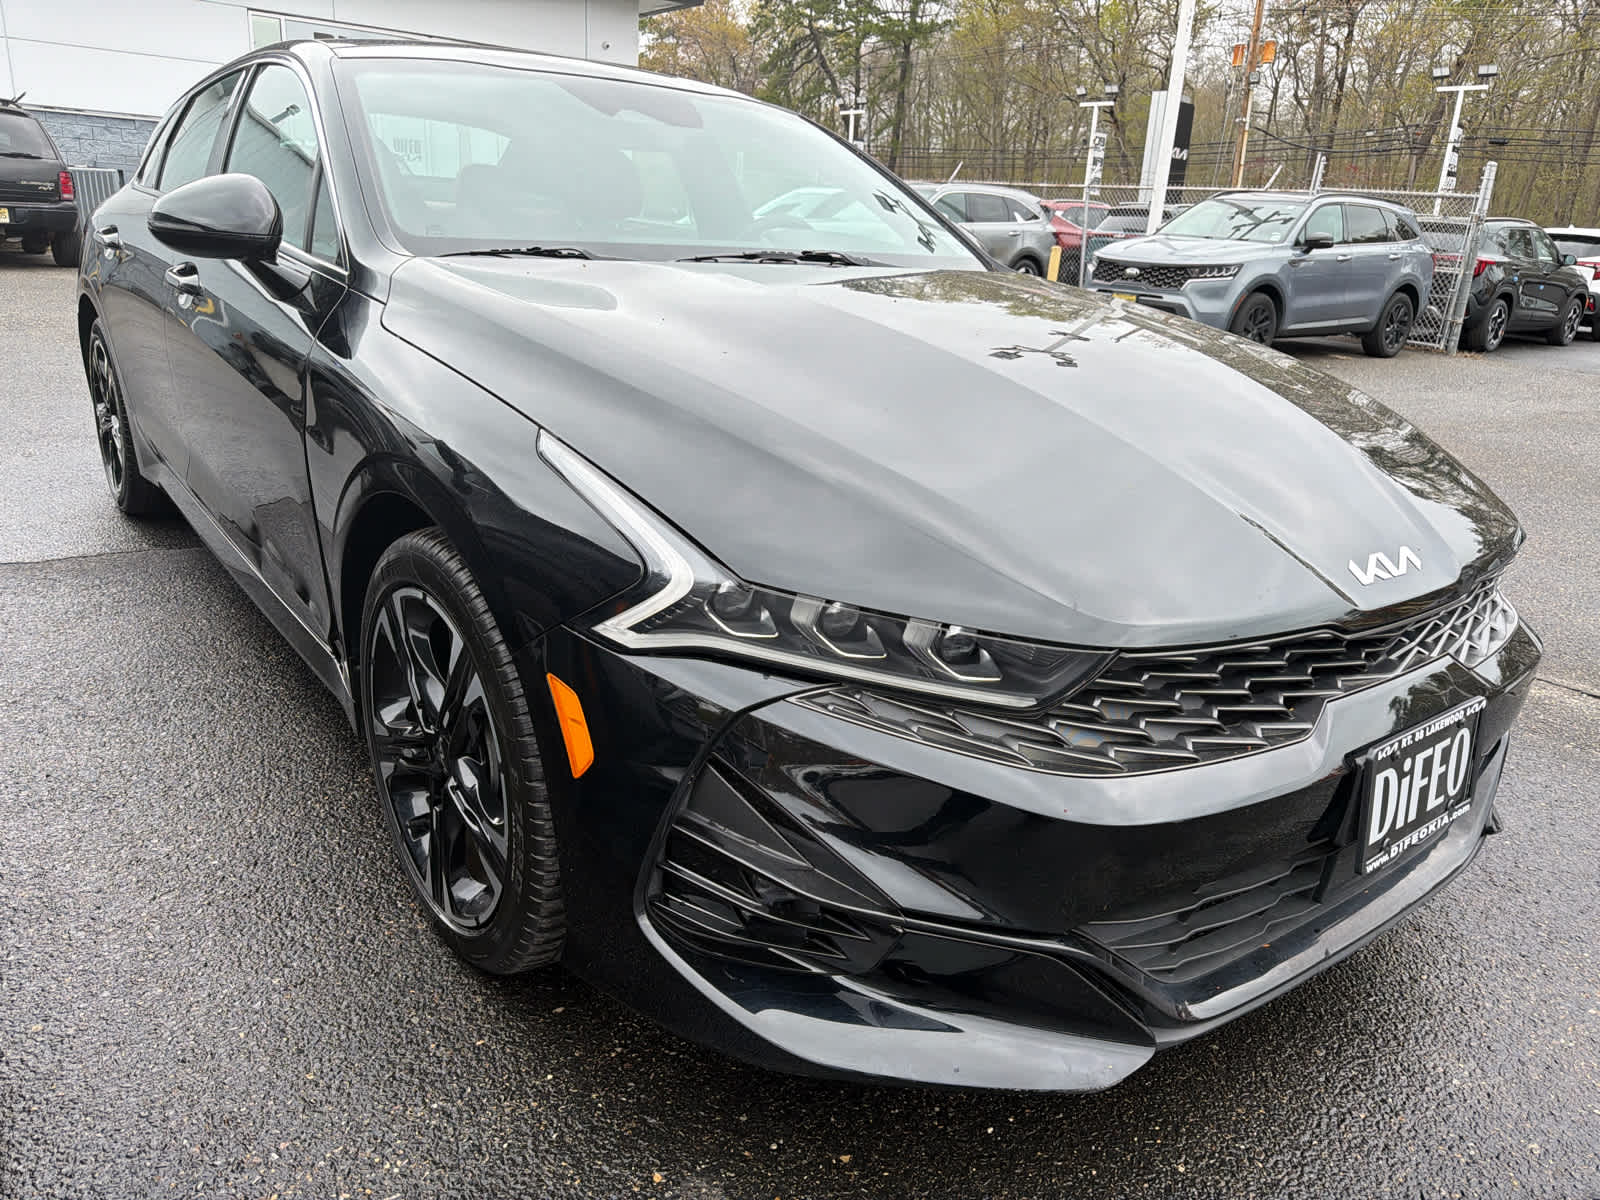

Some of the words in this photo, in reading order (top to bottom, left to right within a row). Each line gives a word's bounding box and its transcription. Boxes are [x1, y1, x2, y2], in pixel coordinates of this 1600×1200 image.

[1347, 545, 1422, 586] KIA
[1377, 742, 1399, 761] KIA
[1401, 735, 1413, 749] RT.
[1414, 729, 1424, 742] 88
[1425, 710, 1465, 737] LAKEWOOD
[1368, 727, 1471, 846] DiFEO
